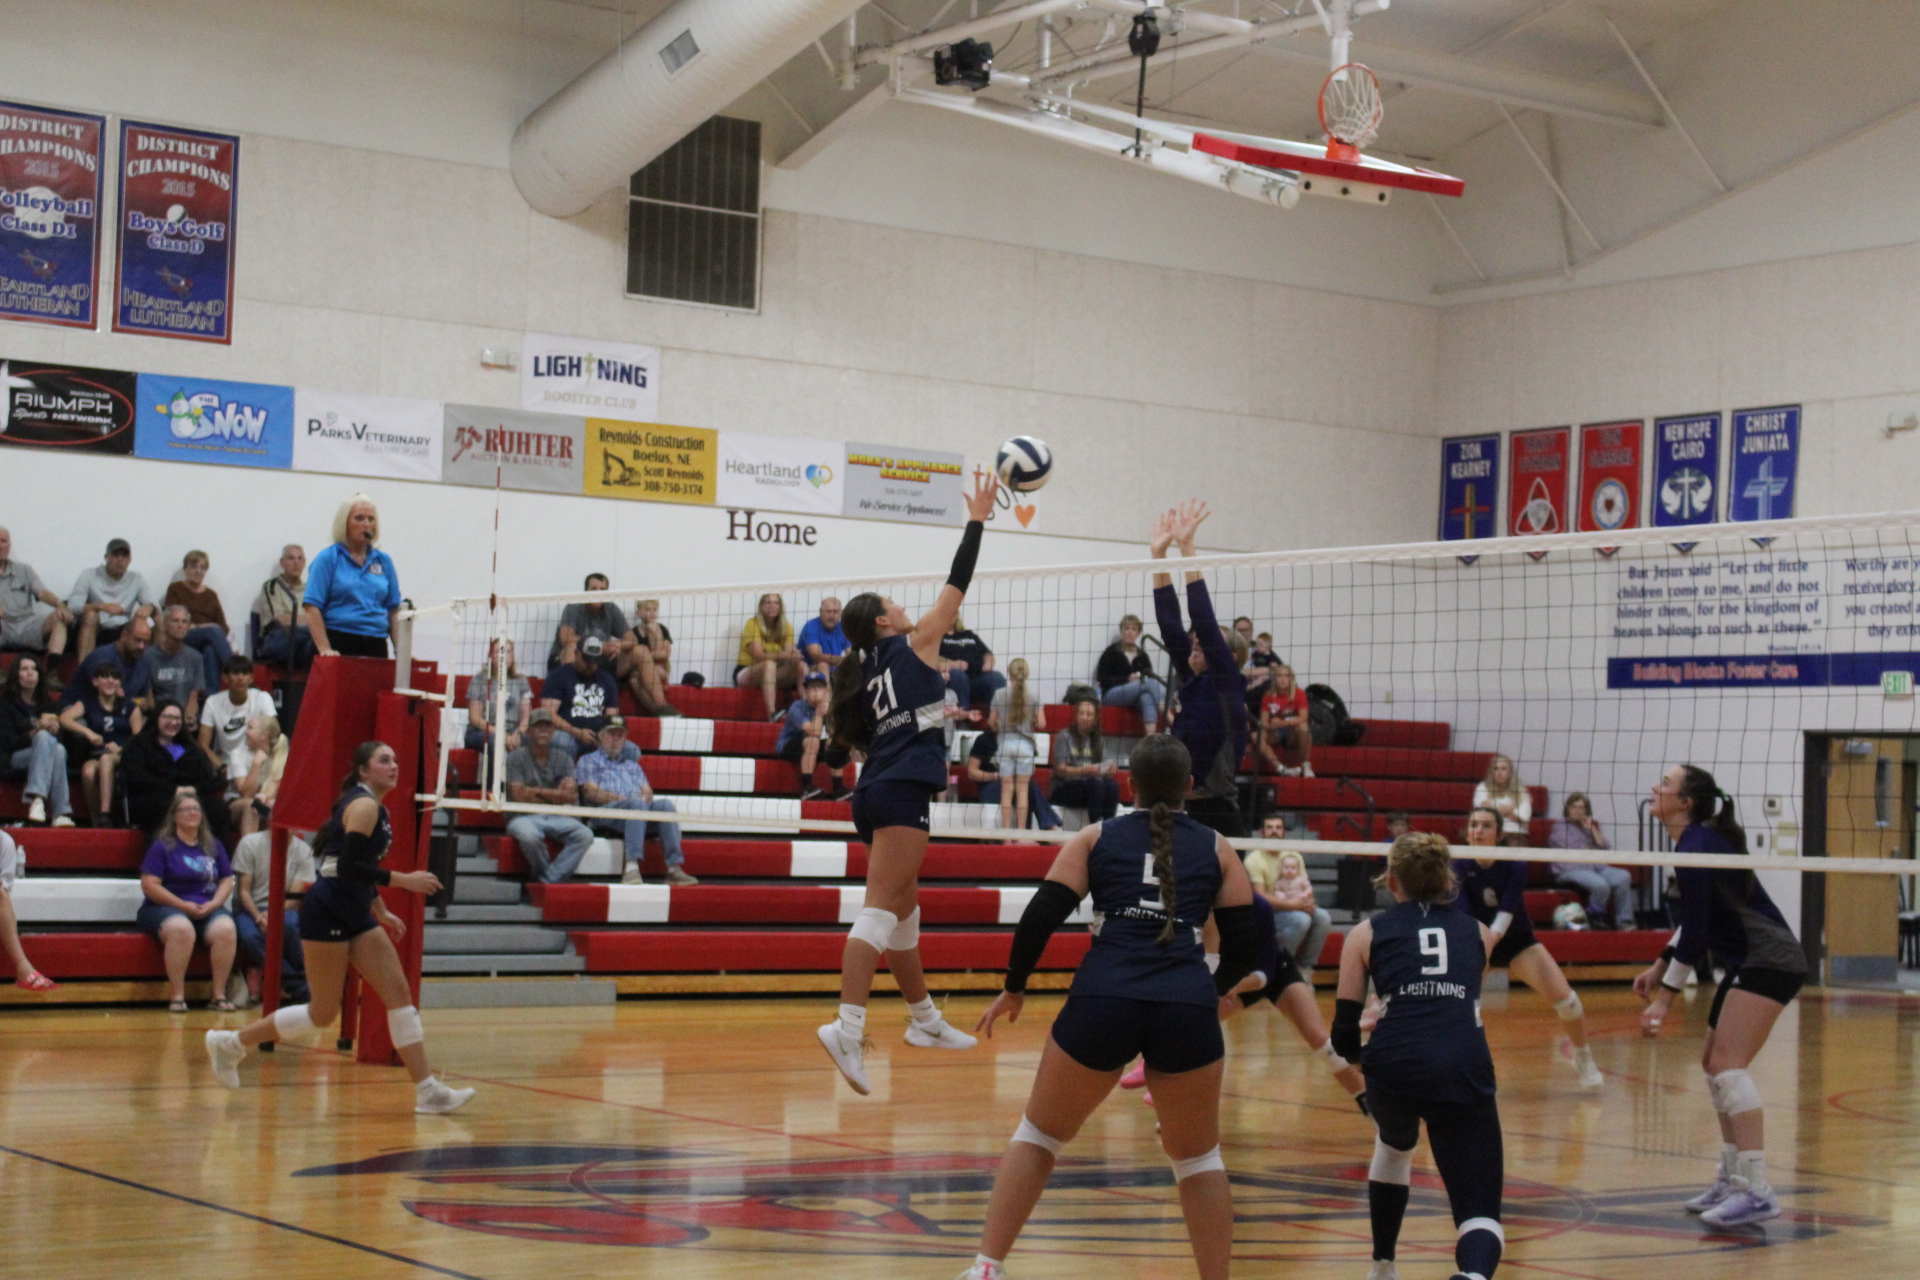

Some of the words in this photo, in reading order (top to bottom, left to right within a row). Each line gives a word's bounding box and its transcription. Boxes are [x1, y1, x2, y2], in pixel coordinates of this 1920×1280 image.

[0, 114, 84, 140] DISTRICT
[0, 138, 96, 172] HAMPIONS
[137, 134, 219, 160] DISTRICT
[127, 159, 230, 191] CHAMPIONS
[1, 215, 47, 233] Class
[129, 211, 177, 236] Boys
[180, 218, 225, 241] Golf
[147, 235, 189, 253] Class
[0, 277, 89, 300] EARTLAND
[124, 287, 224, 316] HEARTLAND
[130, 308, 215, 332] LUTHERAN
[544, 390, 602, 405] BOOSTER
[604, 396, 637, 409] CLUB
[53, 412, 114, 424] NETWORK
[1745, 412, 1787, 433] CHRIST
[307, 418, 352, 440] PARKS
[352, 422, 431, 446] VETERINARY
[600, 427, 642, 446] Reynolds
[645, 432, 704, 451] Construction
[1664, 423, 1685, 442] NEW
[1686, 420, 1711, 440] HOPE
[485, 428, 573, 460] RUHTER
[1671, 441, 1705, 460] CAIRO
[1742, 433, 1790, 454] JUNIATA
[644, 466, 664, 478] Scott
[667, 467, 704, 481] Reynolds
[725, 459, 801, 479] Heartland
[880, 467, 930, 483] SERVICE
[896, 459, 962, 475] APPLIANCE
[1451, 459, 1491, 479] KEARNEY
[755, 477, 800, 487] RADIOLOGY
[873, 499, 902, 512] Service
[727, 509, 818, 547] Home
[1628, 566, 1648, 579] But
[1653, 564, 1683, 580] Jesus
[1689, 563, 1712, 577] said
[1754, 561, 1773, 573] the
[1778, 559, 1808, 572] little
[1892, 559, 1909, 570] are
[1617, 585, 1662, 599] children
[1669, 586, 1698, 597] come
[1704, 584, 1716, 595] to
[1748, 581, 1771, 594] and
[1776, 579, 1792, 593] do
[1798, 580, 1820, 592] not
[1617, 605, 1653, 619] hinder
[1697, 602, 1715, 616] for
[1719, 602, 1739, 615] the
[1745, 599, 1801, 617] kingdom
[1805, 598, 1820, 612] of
[1845, 604, 1867, 619] you
[1869, 600, 1912, 615] created
[1657, 624, 1704, 639] belongs
[1707, 624, 1720, 635] to
[1725, 622, 1752, 634] such
[1757, 623, 1770, 634] as
[867, 667, 898, 720] 21
[1885, 673, 1907, 694] EXIT
[1418, 927, 1449, 976] 9
[1400, 981, 1466, 999] LIGHTNING
